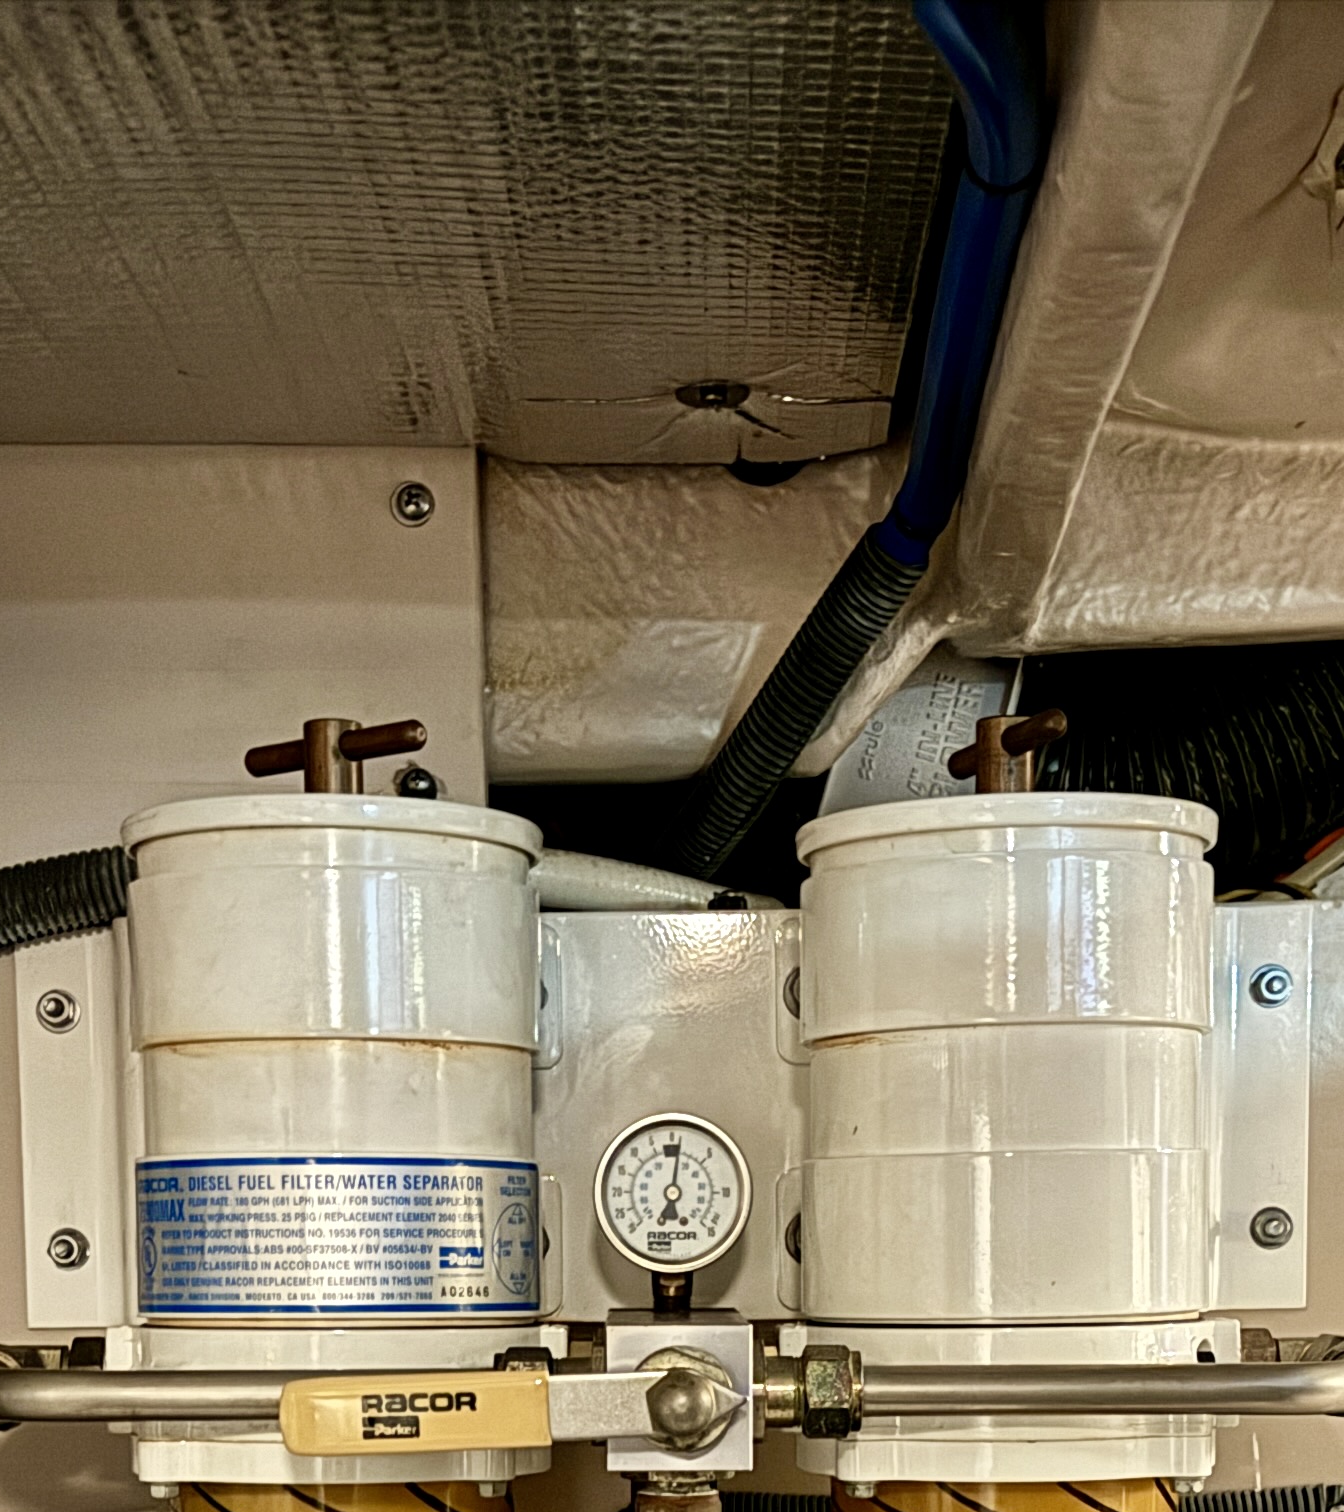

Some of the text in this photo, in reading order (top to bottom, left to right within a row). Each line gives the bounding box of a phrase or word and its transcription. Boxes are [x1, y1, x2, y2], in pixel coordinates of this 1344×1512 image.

[915, 671, 956, 763] IN-LINE
[188, 1176, 233, 1192] DIESEL
[238, 1174, 276, 1190] FUEL
[281, 1174, 397, 1190] FILTER/WATER
[403, 1174, 484, 1192] SEPARATOR
[349, 1196, 369, 1207] FOR
[371, 1196, 411, 1207] SUCTION
[413, 1196, 433, 1207] SIDE
[281, 1212, 292, 1223] 25
[324, 1212, 394, 1223] REPLACEMENT
[395, 1212, 437, 1223] ELEMENT
[234, 1228, 305, 1239] INSTRUCTIONS
[359, 1228, 380, 1239] FOR
[383, 1228, 424, 1239] SERVICE
[365, 1244, 381, 1255] BV
[448, 1253, 483, 1266] Parker
[260, 1260, 271, 1271] IN
[273, 1260, 351, 1271] ACCORDANCE
[353, 1260, 382, 1271] WITH
[225, 1276, 255, 1287] RACOR
[256, 1276, 325, 1287] REPLACEMENT
[327, 1276, 377, 1287] ELEMENTS
[379, 1276, 390, 1287] IN
[392, 1276, 413, 1287] THIS
[414, 1276, 434, 1287] UNIT
[374, 1422, 417, 1437] Parker
